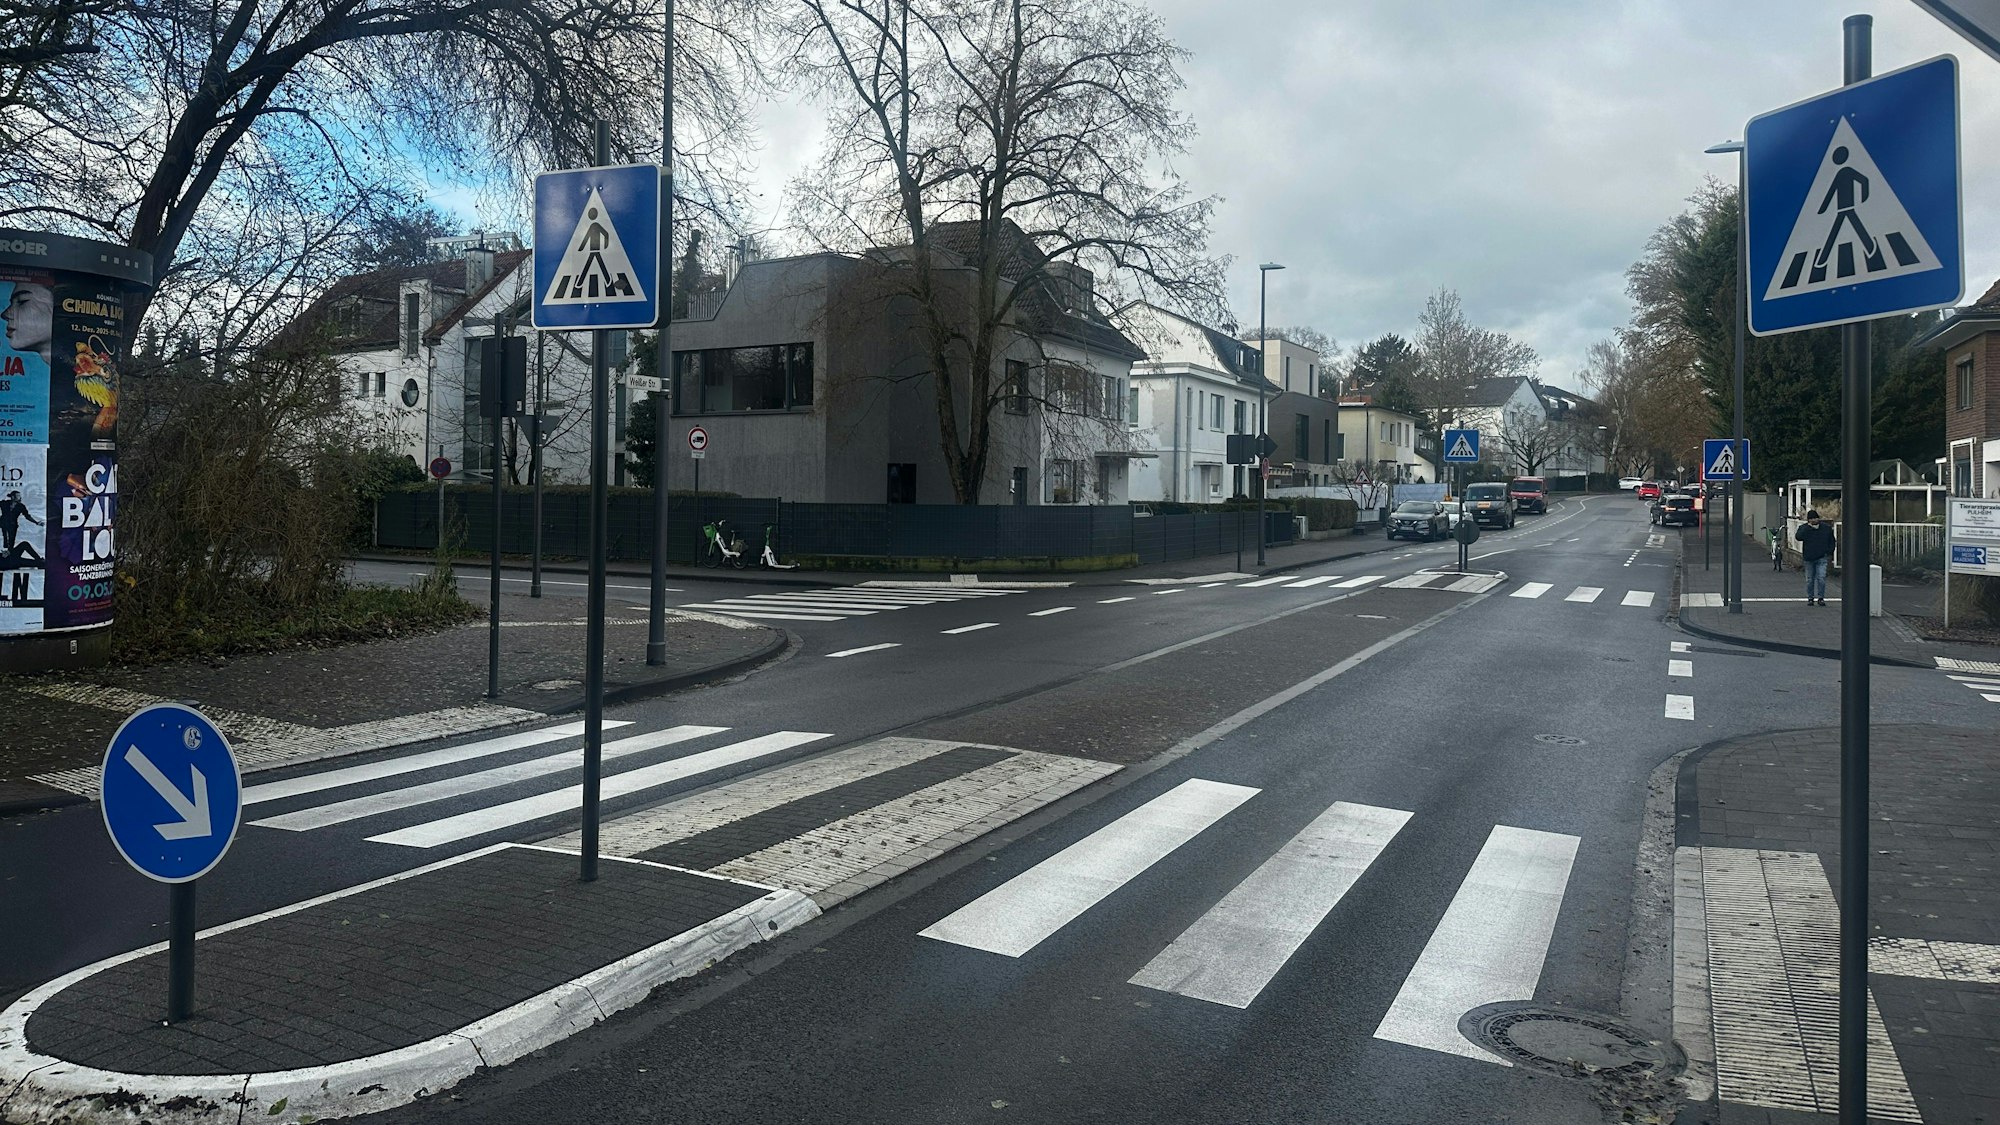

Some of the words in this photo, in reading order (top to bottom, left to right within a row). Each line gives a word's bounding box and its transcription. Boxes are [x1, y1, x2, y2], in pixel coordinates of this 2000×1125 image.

[62, 298, 109, 317] CHINA
[82, 325, 95, 333] Dez.
[0, 356, 25, 376] IA
[62, 496, 111, 528] BAL
